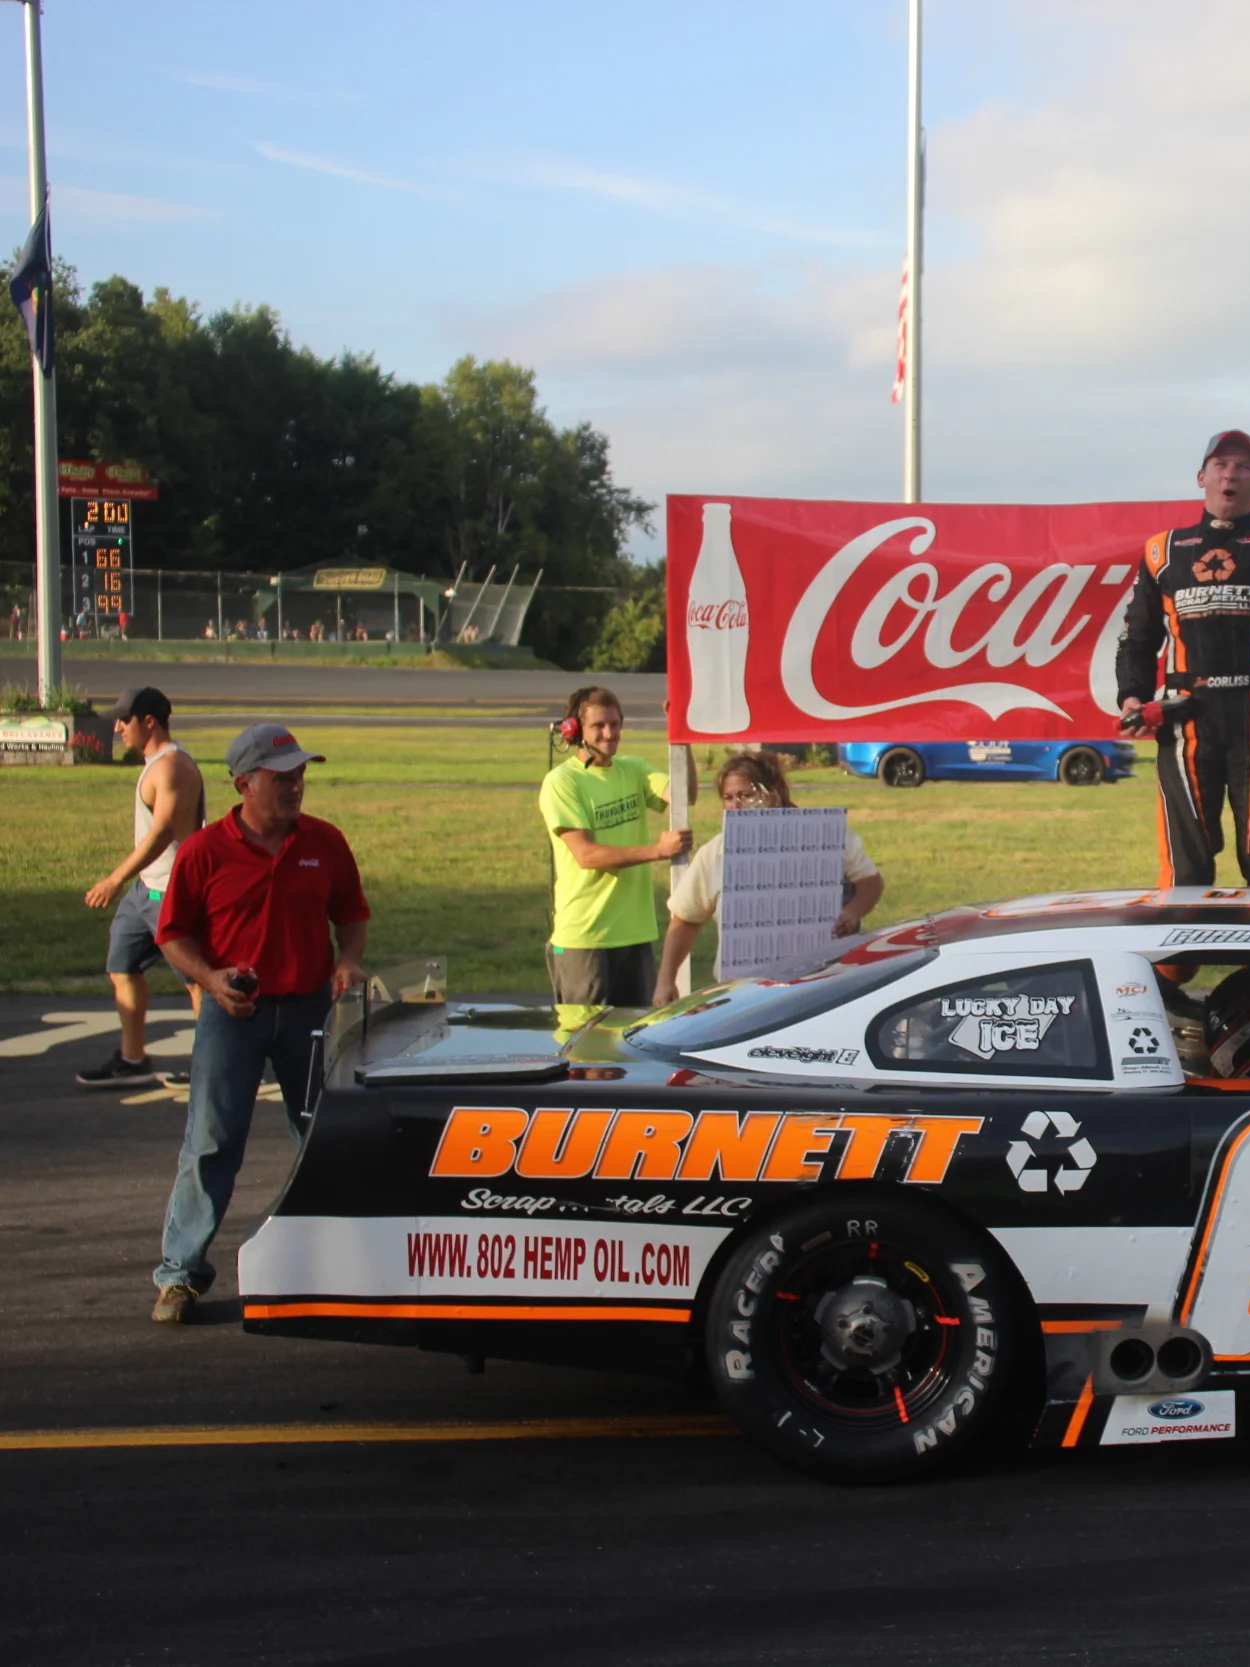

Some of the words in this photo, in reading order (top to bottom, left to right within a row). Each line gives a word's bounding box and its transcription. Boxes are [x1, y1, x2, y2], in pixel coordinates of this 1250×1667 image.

[107, 525, 126, 533] TIME
[82, 551, 88, 563] 1
[96, 548, 121, 568] 66
[82, 575, 89, 587] 2
[104, 571, 121, 592] 16
[82, 597, 90, 610] 3
[97, 594, 122, 615] 99
[1176, 596, 1209, 607] SCRAP
[688, 600, 746, 630] Coca-Cola
[1208, 675, 1250, 688] CORLISS
[38, 743, 64, 751] Hauling
[940, 996, 1017, 1017] LUCKY
[1030, 996, 1075, 1016] DAY
[978, 1019, 1040, 1053] ICE
[429, 1106, 985, 1183] BURNETT
[682, 1195, 752, 1216] LLC
[846, 1219, 879, 1238] RR
[523, 1236, 587, 1281] HEMP
[913, 1262, 997, 1455] AMERICAN
[1159, 1401, 1192, 1416] Ford
[1122, 1427, 1149, 1436] FORD
[1151, 1424, 1231, 1435] PERFORMANCE
